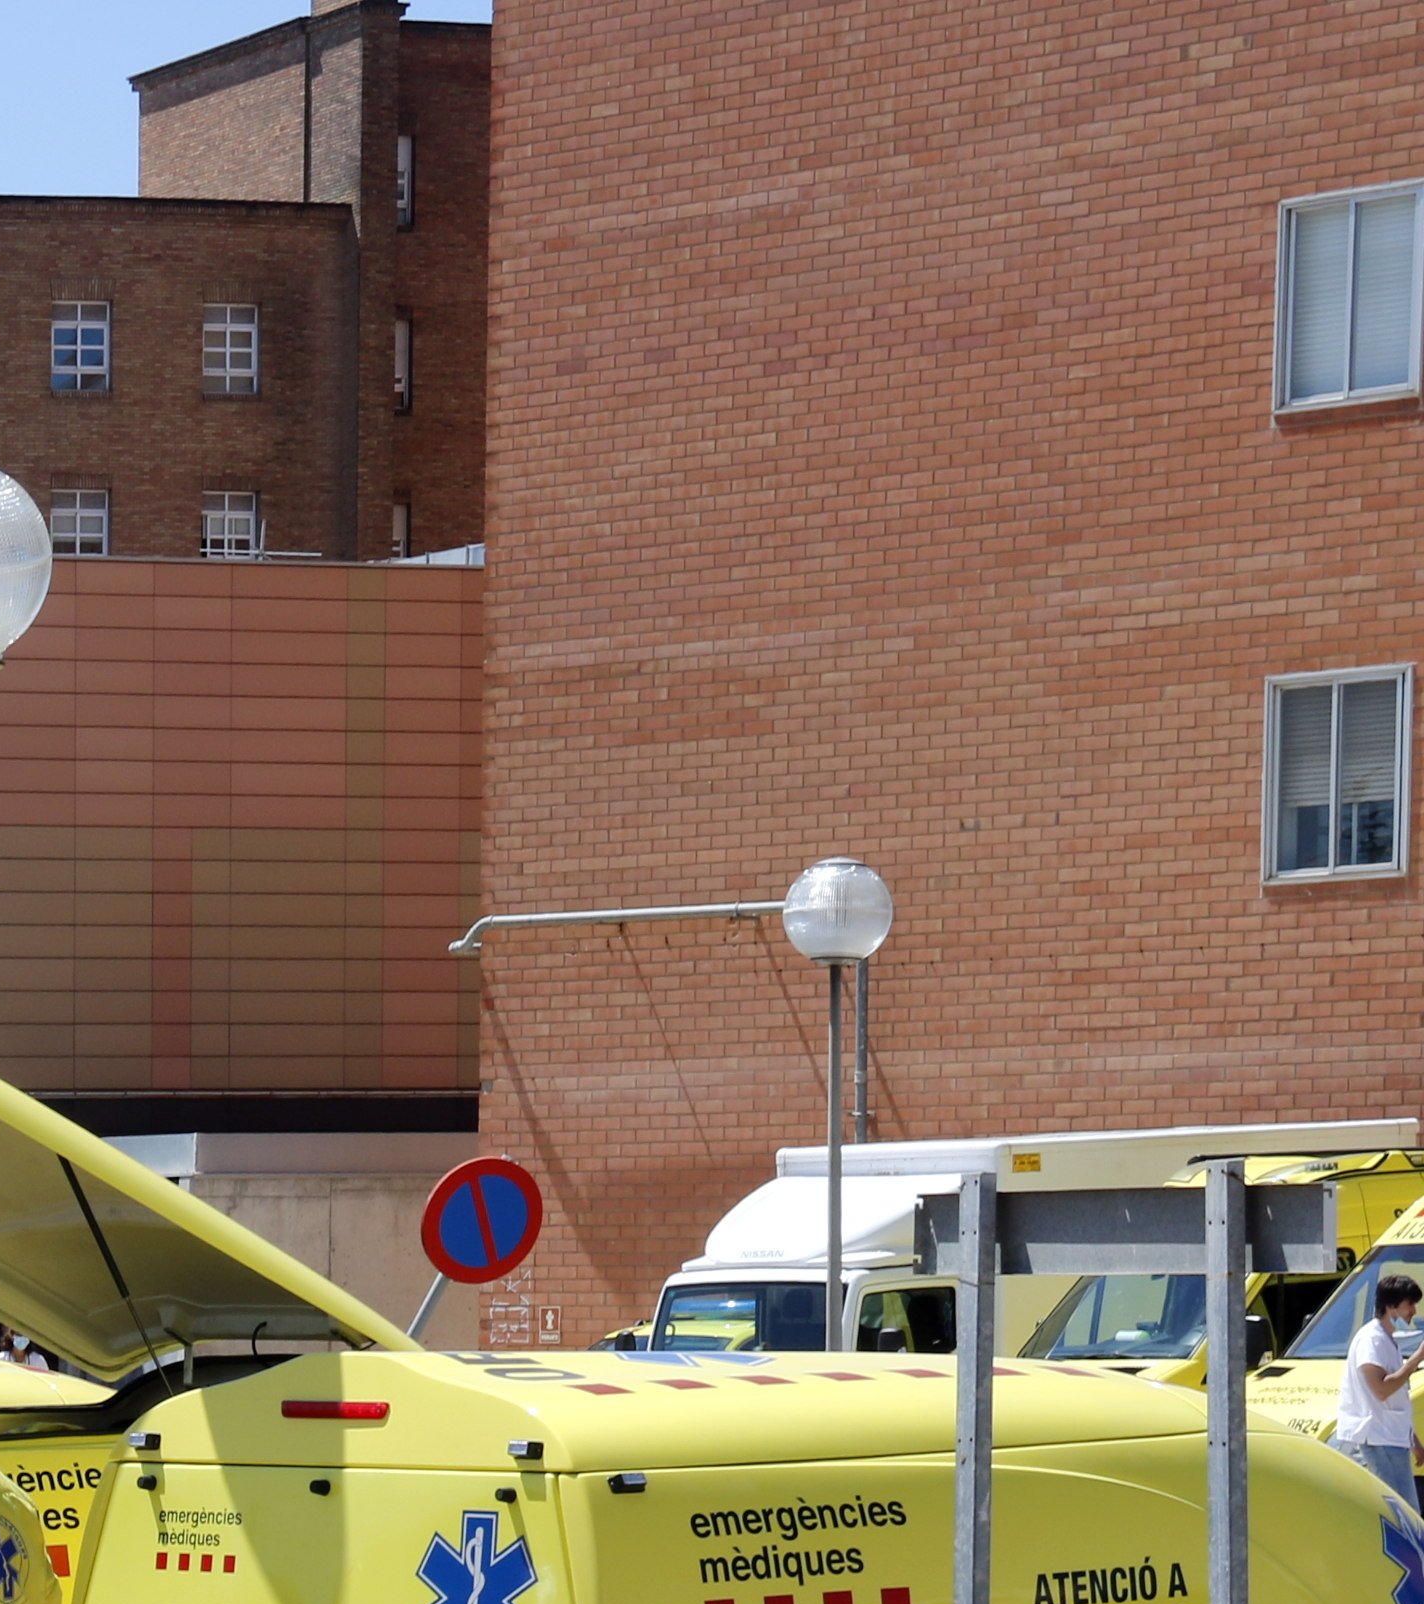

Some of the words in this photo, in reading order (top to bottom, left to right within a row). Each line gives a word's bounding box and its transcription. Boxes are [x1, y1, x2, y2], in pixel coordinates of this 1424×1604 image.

[740, 1249, 785, 1259] NISSAN
[158, 1508, 243, 1532] emergències
[690, 1495, 907, 1541] emergències
[157, 1528, 221, 1549] mèdiques
[699, 1545, 865, 1586] mèdiques
[1168, 1562, 1188, 1598] A
